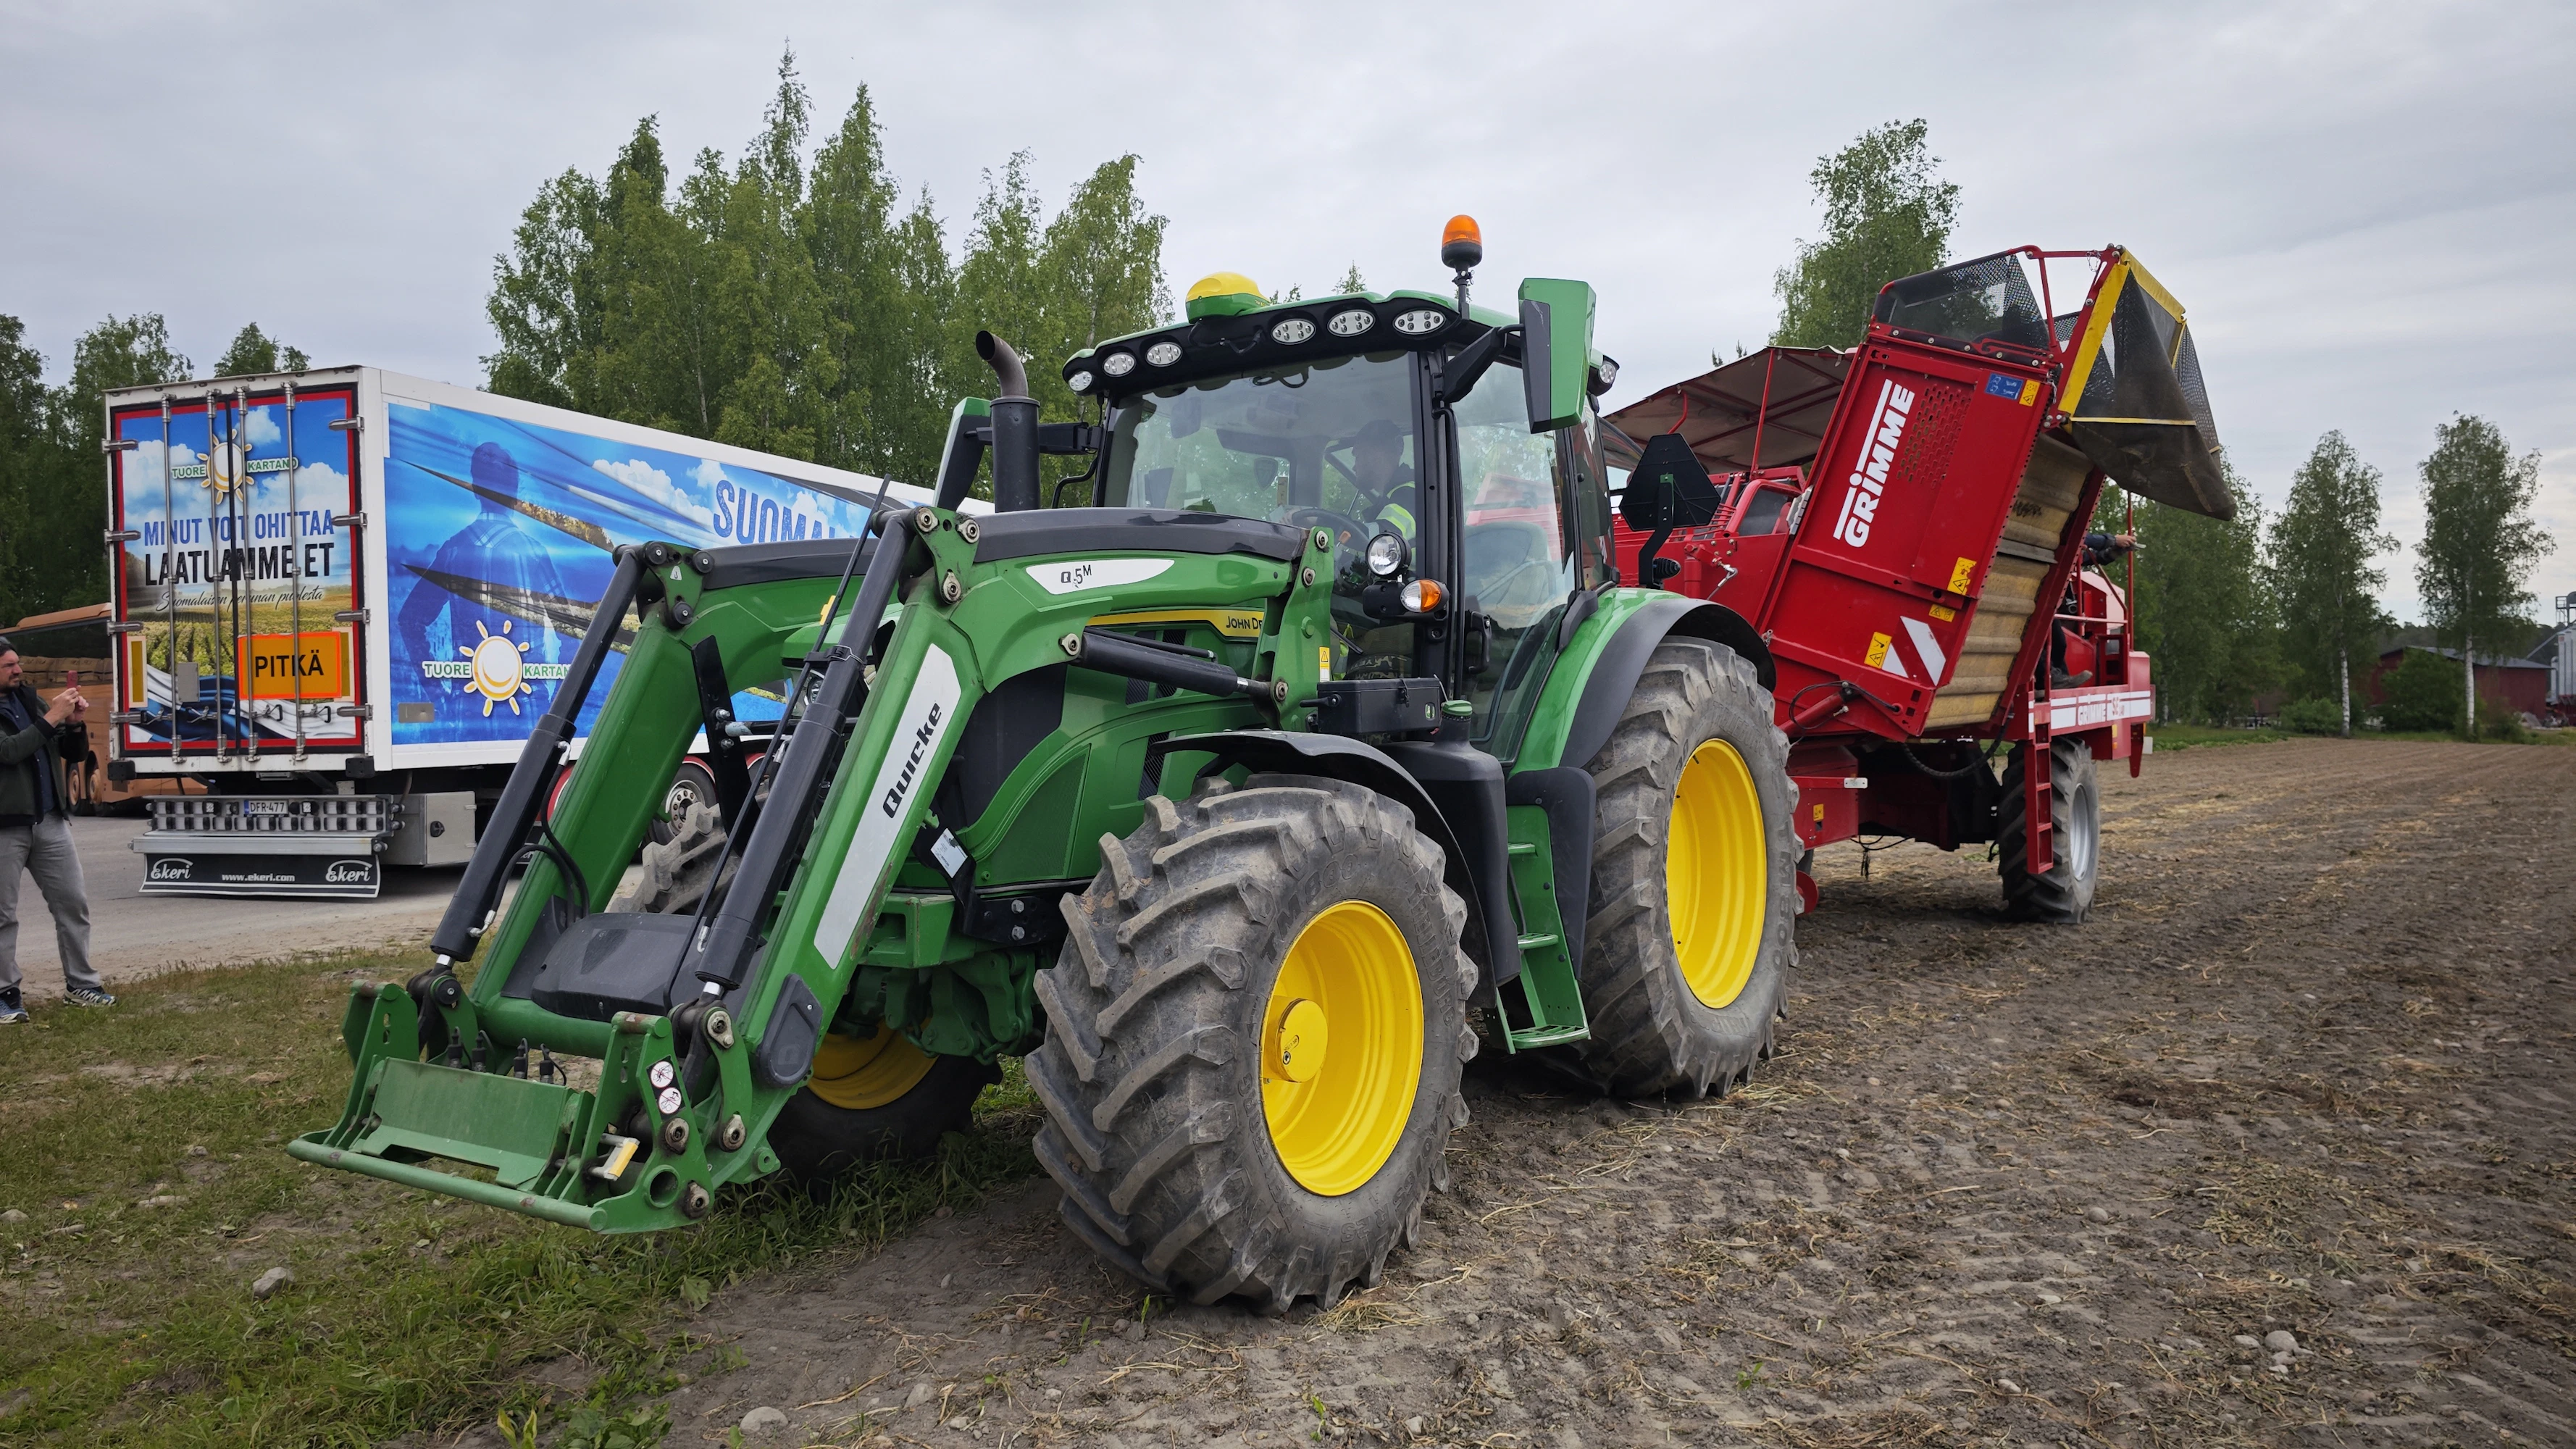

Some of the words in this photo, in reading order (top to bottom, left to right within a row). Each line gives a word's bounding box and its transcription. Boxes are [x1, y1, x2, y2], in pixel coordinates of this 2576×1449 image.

[172, 466, 206, 477] TUORE
[248, 459, 297, 471] KARTANO
[1844, 384, 1915, 548] GRIMME
[145, 518, 202, 546] MINUT
[255, 509, 334, 539] OHITTAA
[305, 542, 334, 577] ET
[1226, 615, 1251, 629] JOHN
[255, 649, 325, 677] PITKÄ
[425, 663, 470, 676] TUORE
[883, 703, 942, 819] Quicke
[250, 802, 285, 812] DFR-477
[151, 858, 193, 880] Ekeri
[222, 873, 295, 882] www.ekeri.com
[326, 860, 372, 882] Ekeri
[1260, 853, 1359, 964] TM800
